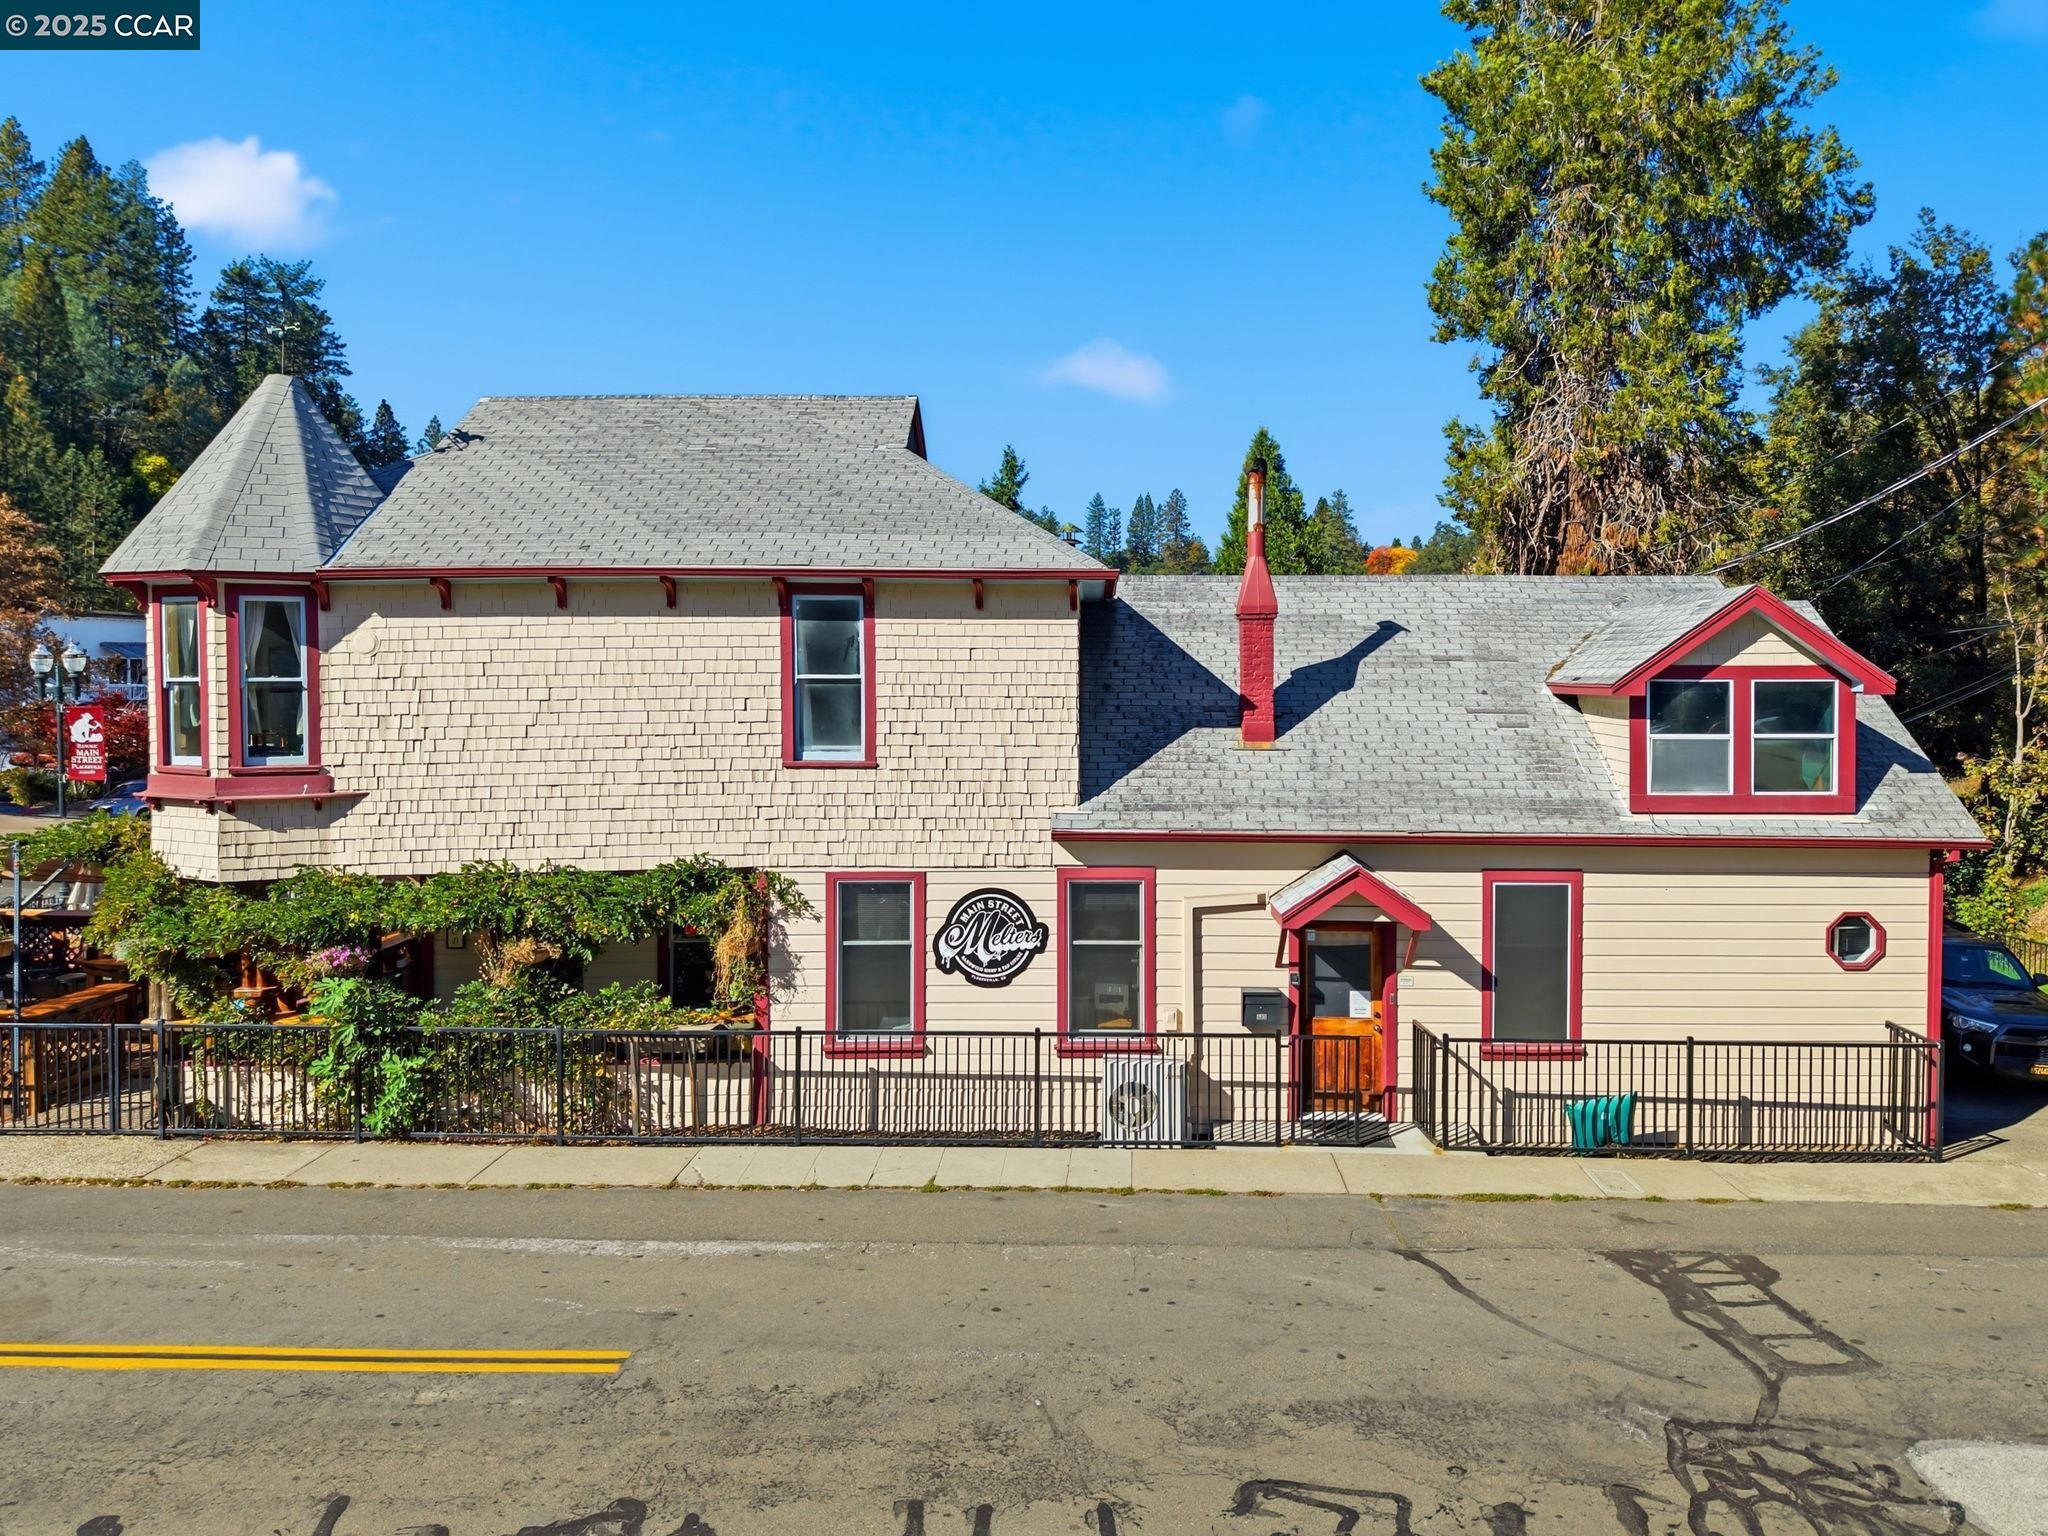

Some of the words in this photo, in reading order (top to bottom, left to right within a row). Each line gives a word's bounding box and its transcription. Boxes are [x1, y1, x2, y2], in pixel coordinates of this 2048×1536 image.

[959, 900, 985, 923] MAIN
[987, 899, 1025, 926] STREET
[939, 910, 1043, 960] Melters
